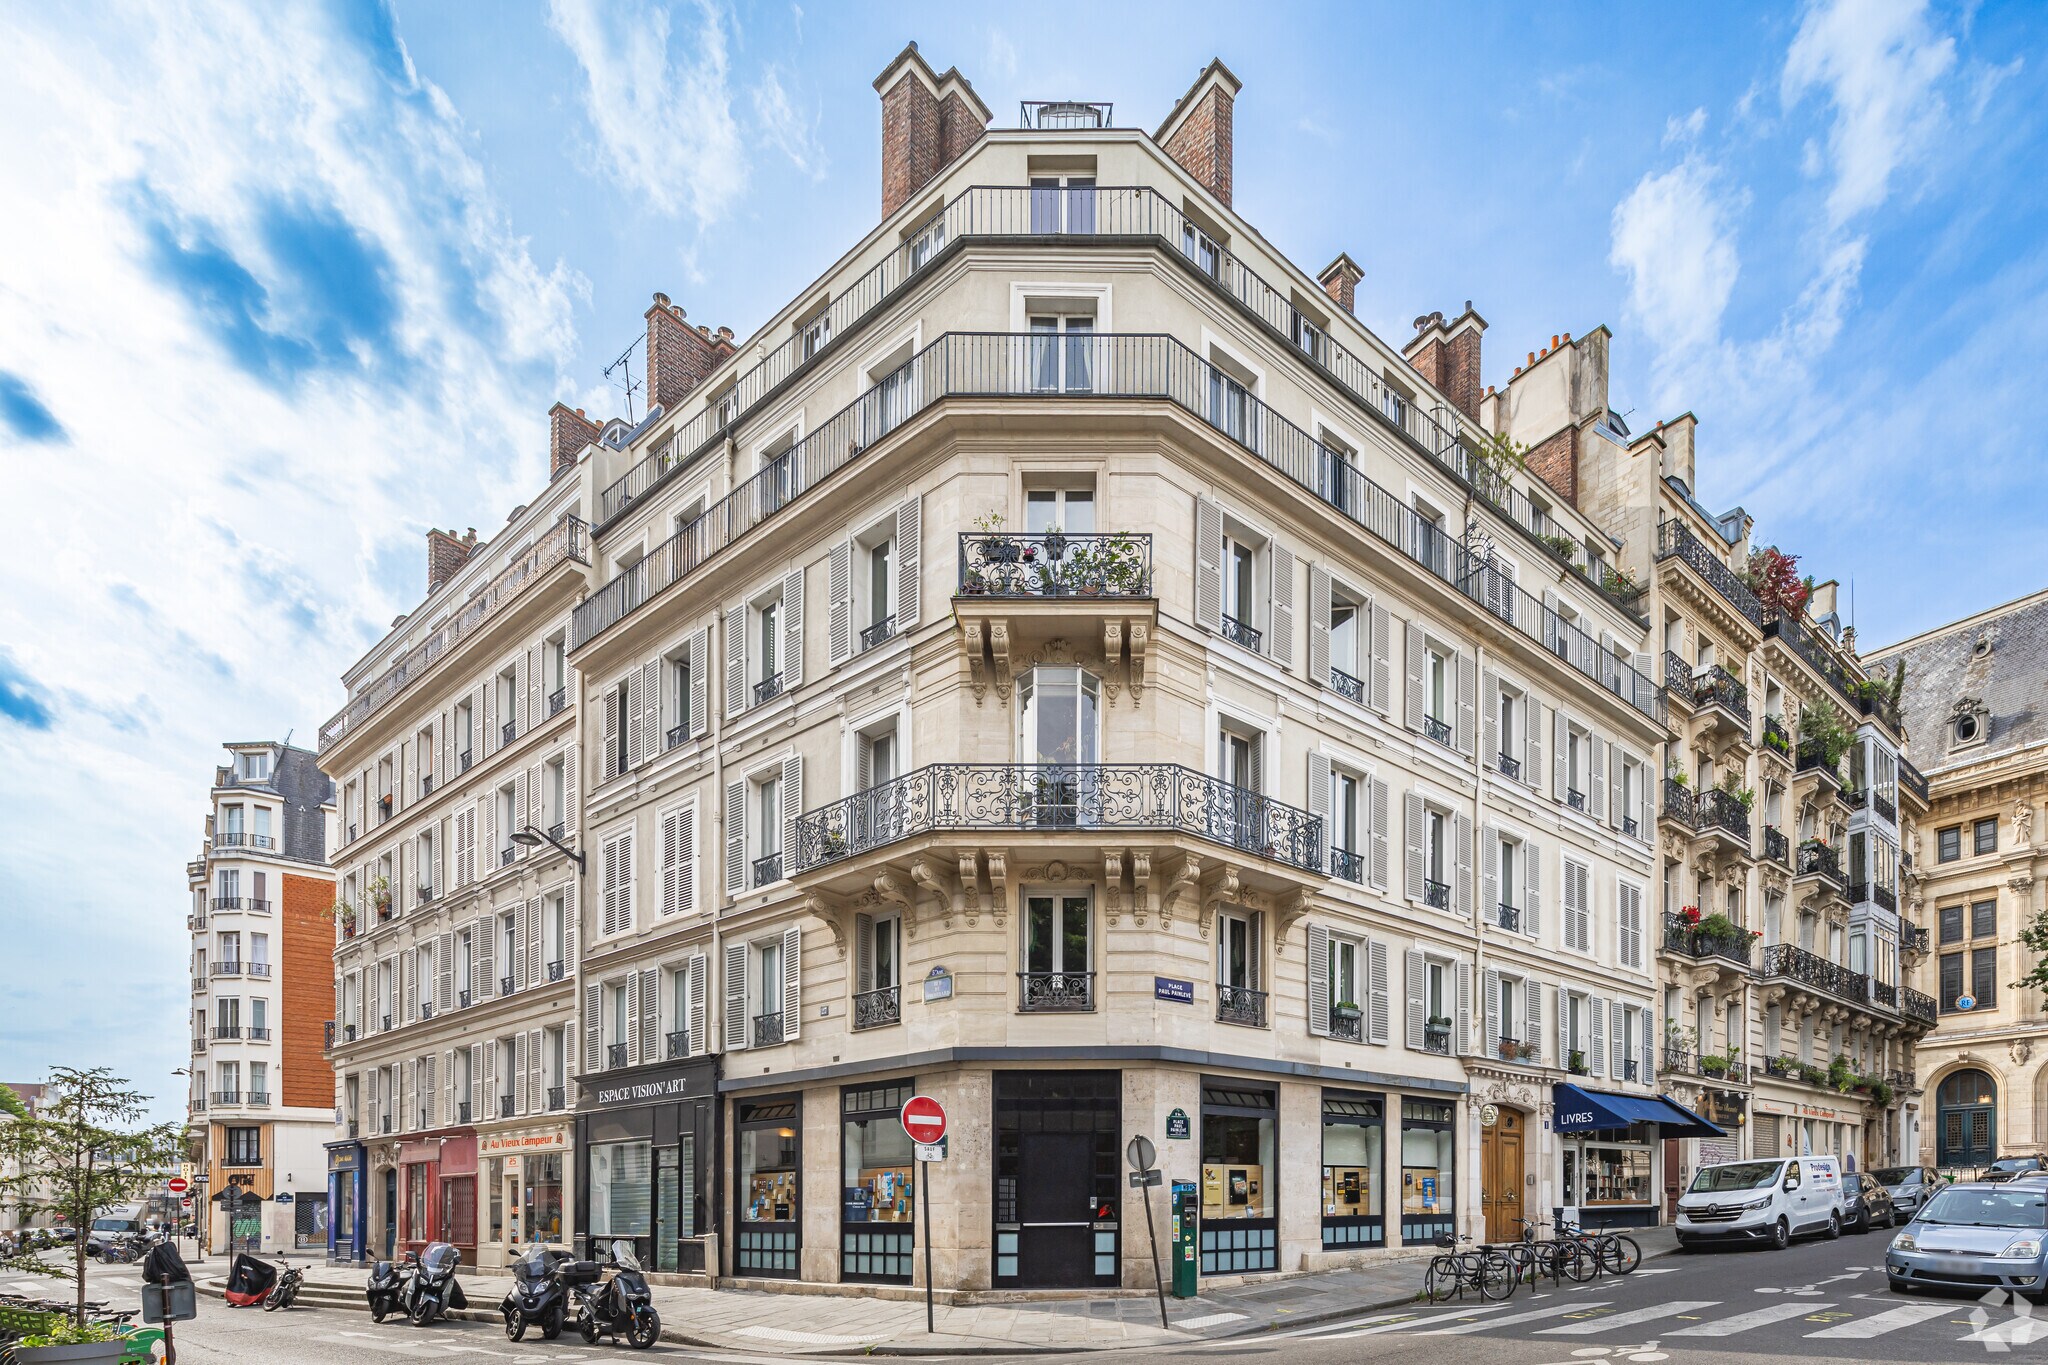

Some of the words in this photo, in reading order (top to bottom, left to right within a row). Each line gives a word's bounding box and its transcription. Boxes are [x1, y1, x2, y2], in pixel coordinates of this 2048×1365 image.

[1168, 983, 1183, 991] PLACE
[598, 1087, 630, 1104] ESPACE
[631, 1078, 687, 1099] VISION'ART
[1560, 1112, 1594, 1125] LIVRES
[490, 1140, 499, 1149] Au
[501, 1138, 520, 1148] Vieux
[521, 1135, 553, 1147] Campeur
[508, 1157, 517, 1166] 25
